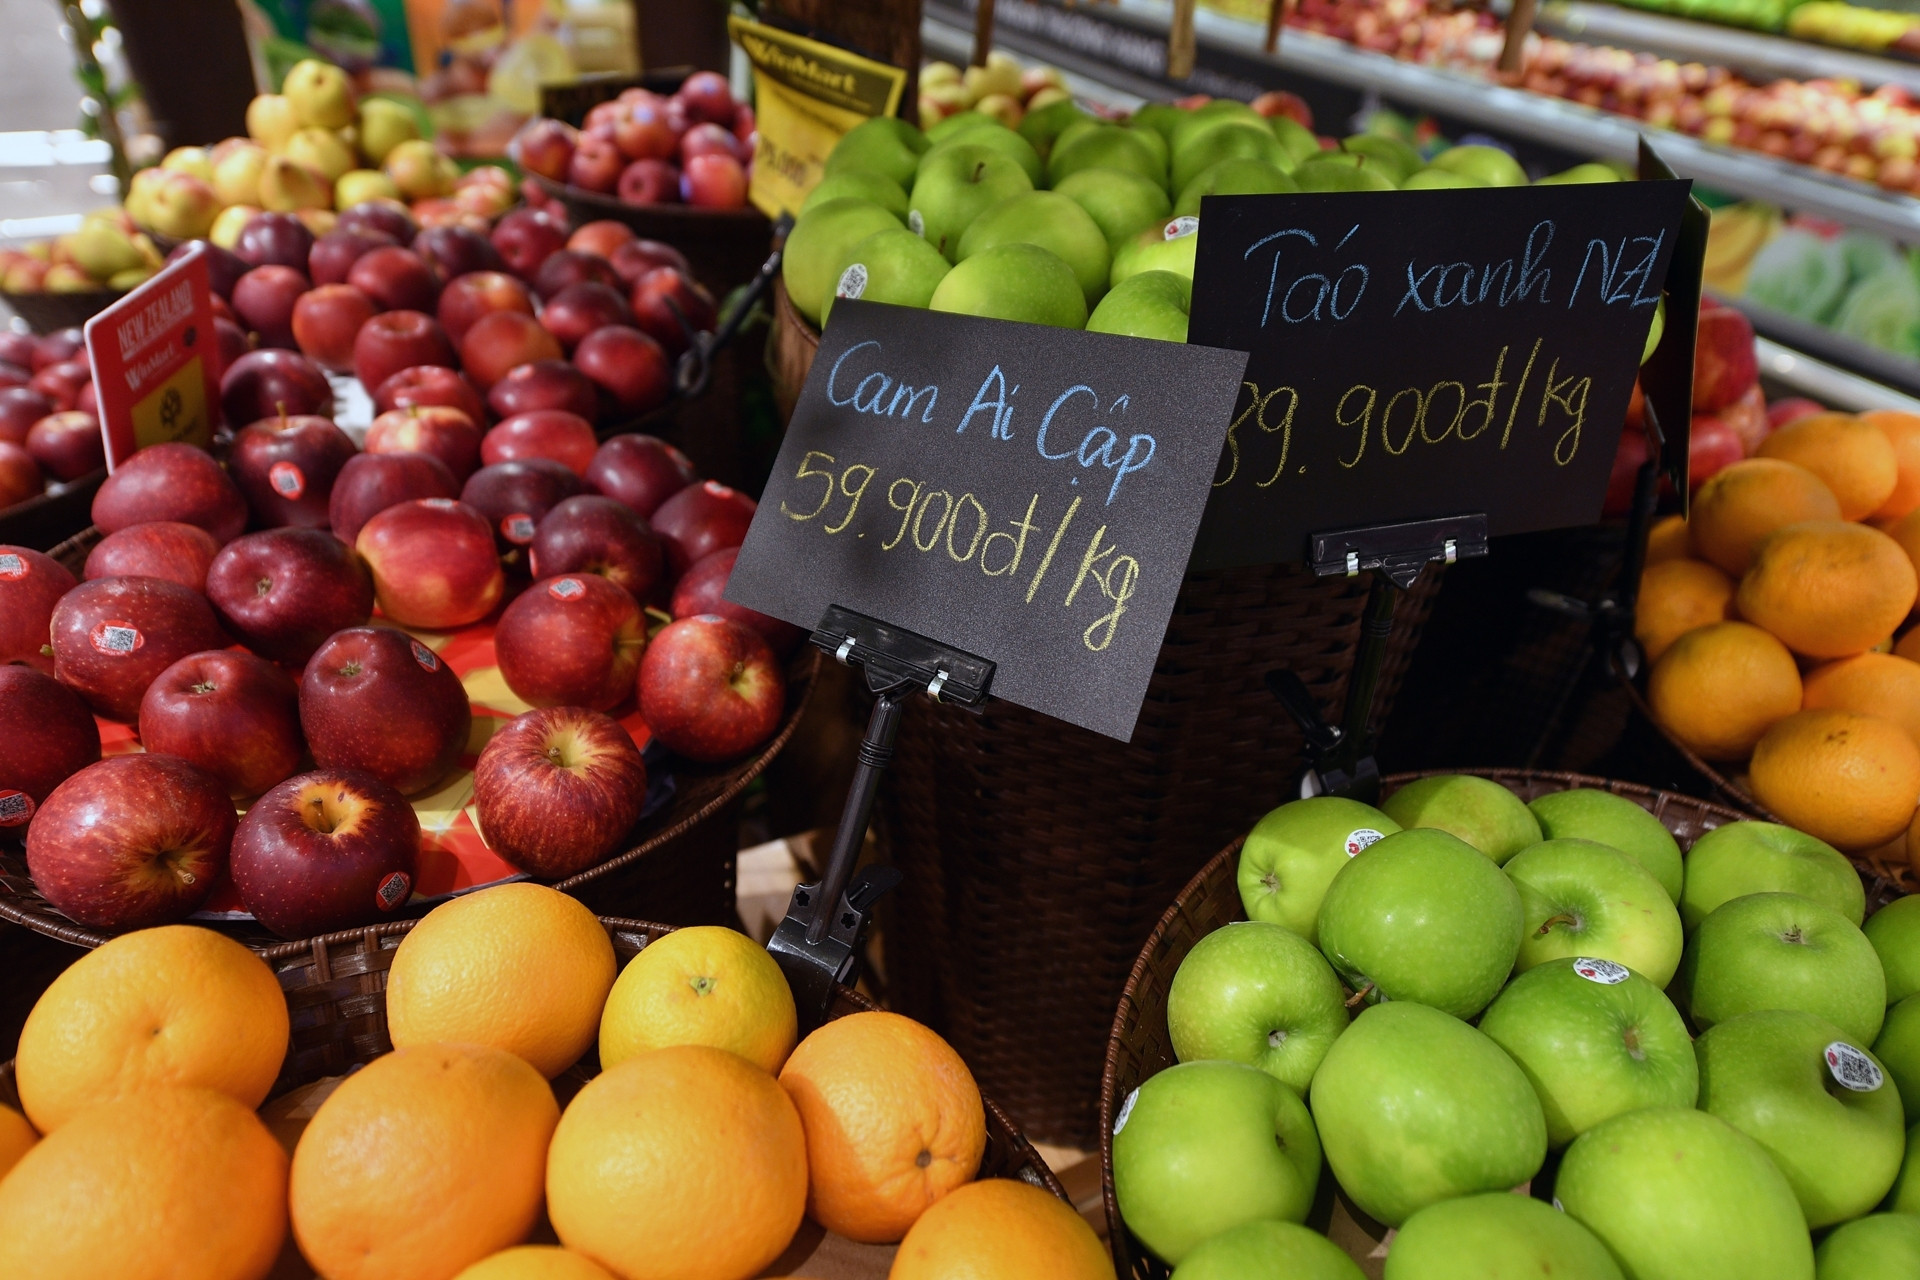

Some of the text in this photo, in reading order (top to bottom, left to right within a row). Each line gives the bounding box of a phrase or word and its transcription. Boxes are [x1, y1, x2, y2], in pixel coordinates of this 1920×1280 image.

[1394, 220, 1556, 317] xanh
[1568, 228, 1665, 310] NZL
[117, 312, 148, 352] NEW
[144, 279, 194, 336] ZEALAND
[827, 341, 938, 422] Cam
